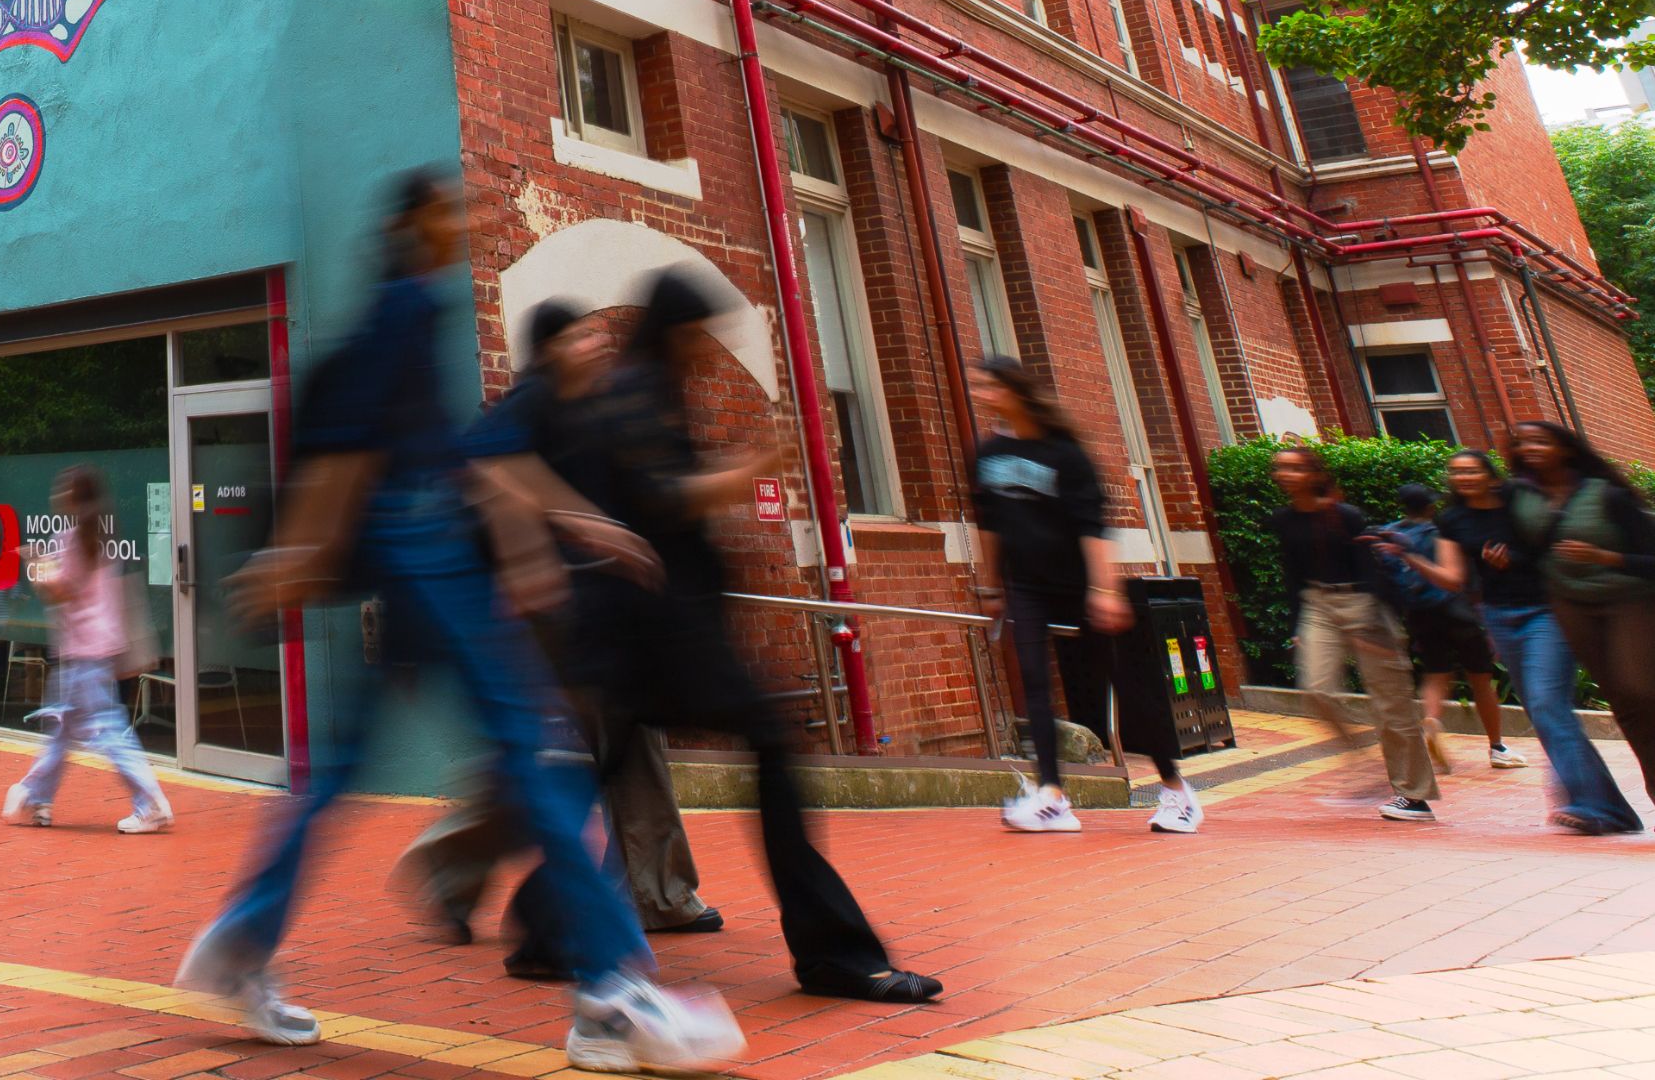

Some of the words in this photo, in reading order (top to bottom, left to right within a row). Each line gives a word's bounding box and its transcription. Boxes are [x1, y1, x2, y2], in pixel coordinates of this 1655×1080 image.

[217, 486, 246, 498] AD108
[759, 484, 776, 497] FIRE
[26, 514, 114, 534] MOONNI
